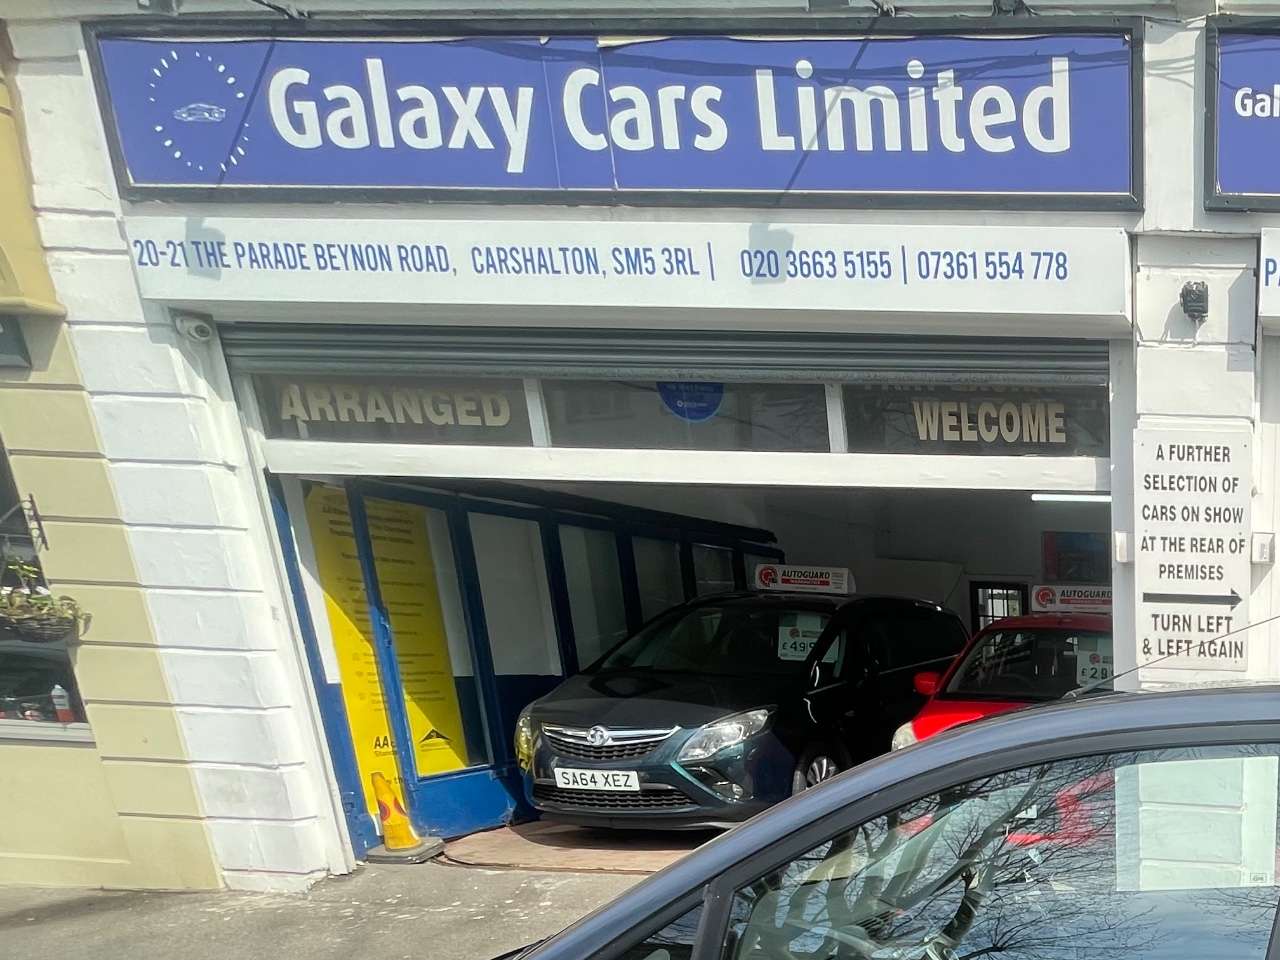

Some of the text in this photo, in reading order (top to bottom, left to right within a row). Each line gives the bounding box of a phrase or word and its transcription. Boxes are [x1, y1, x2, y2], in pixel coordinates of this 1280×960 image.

[268, 57, 1071, 174] Galaxy Cars Limited
[133, 239, 700, 279] 20-21 THE PARADE BEYNON ROAD, CARSHALTON, SM5 3RL
[739, 249, 893, 280] 020 3663 5155
[916, 251, 1069, 282] 07361 554 778
[280, 384, 511, 428] ARRANGED
[912, 400, 1067, 443] WELCOME
[1155, 444, 1231, 463] A FURTHER
[1143, 474, 1240, 494] SELECTION OF
[1142, 504, 1244, 524] CARS ON SHOW
[1140, 535, 1246, 555] AT THE REAR OF
[781, 570, 831, 579] AUTOGUARD
[1158, 564, 1224, 581] PREMISES
[1151, 613, 1233, 634] TURN LEFT
[1142, 638, 1244, 659] & LEFT AGAIN
[1081, 667, 1113, 680] £29
[561, 769, 631, 788] SA64 XEZ
